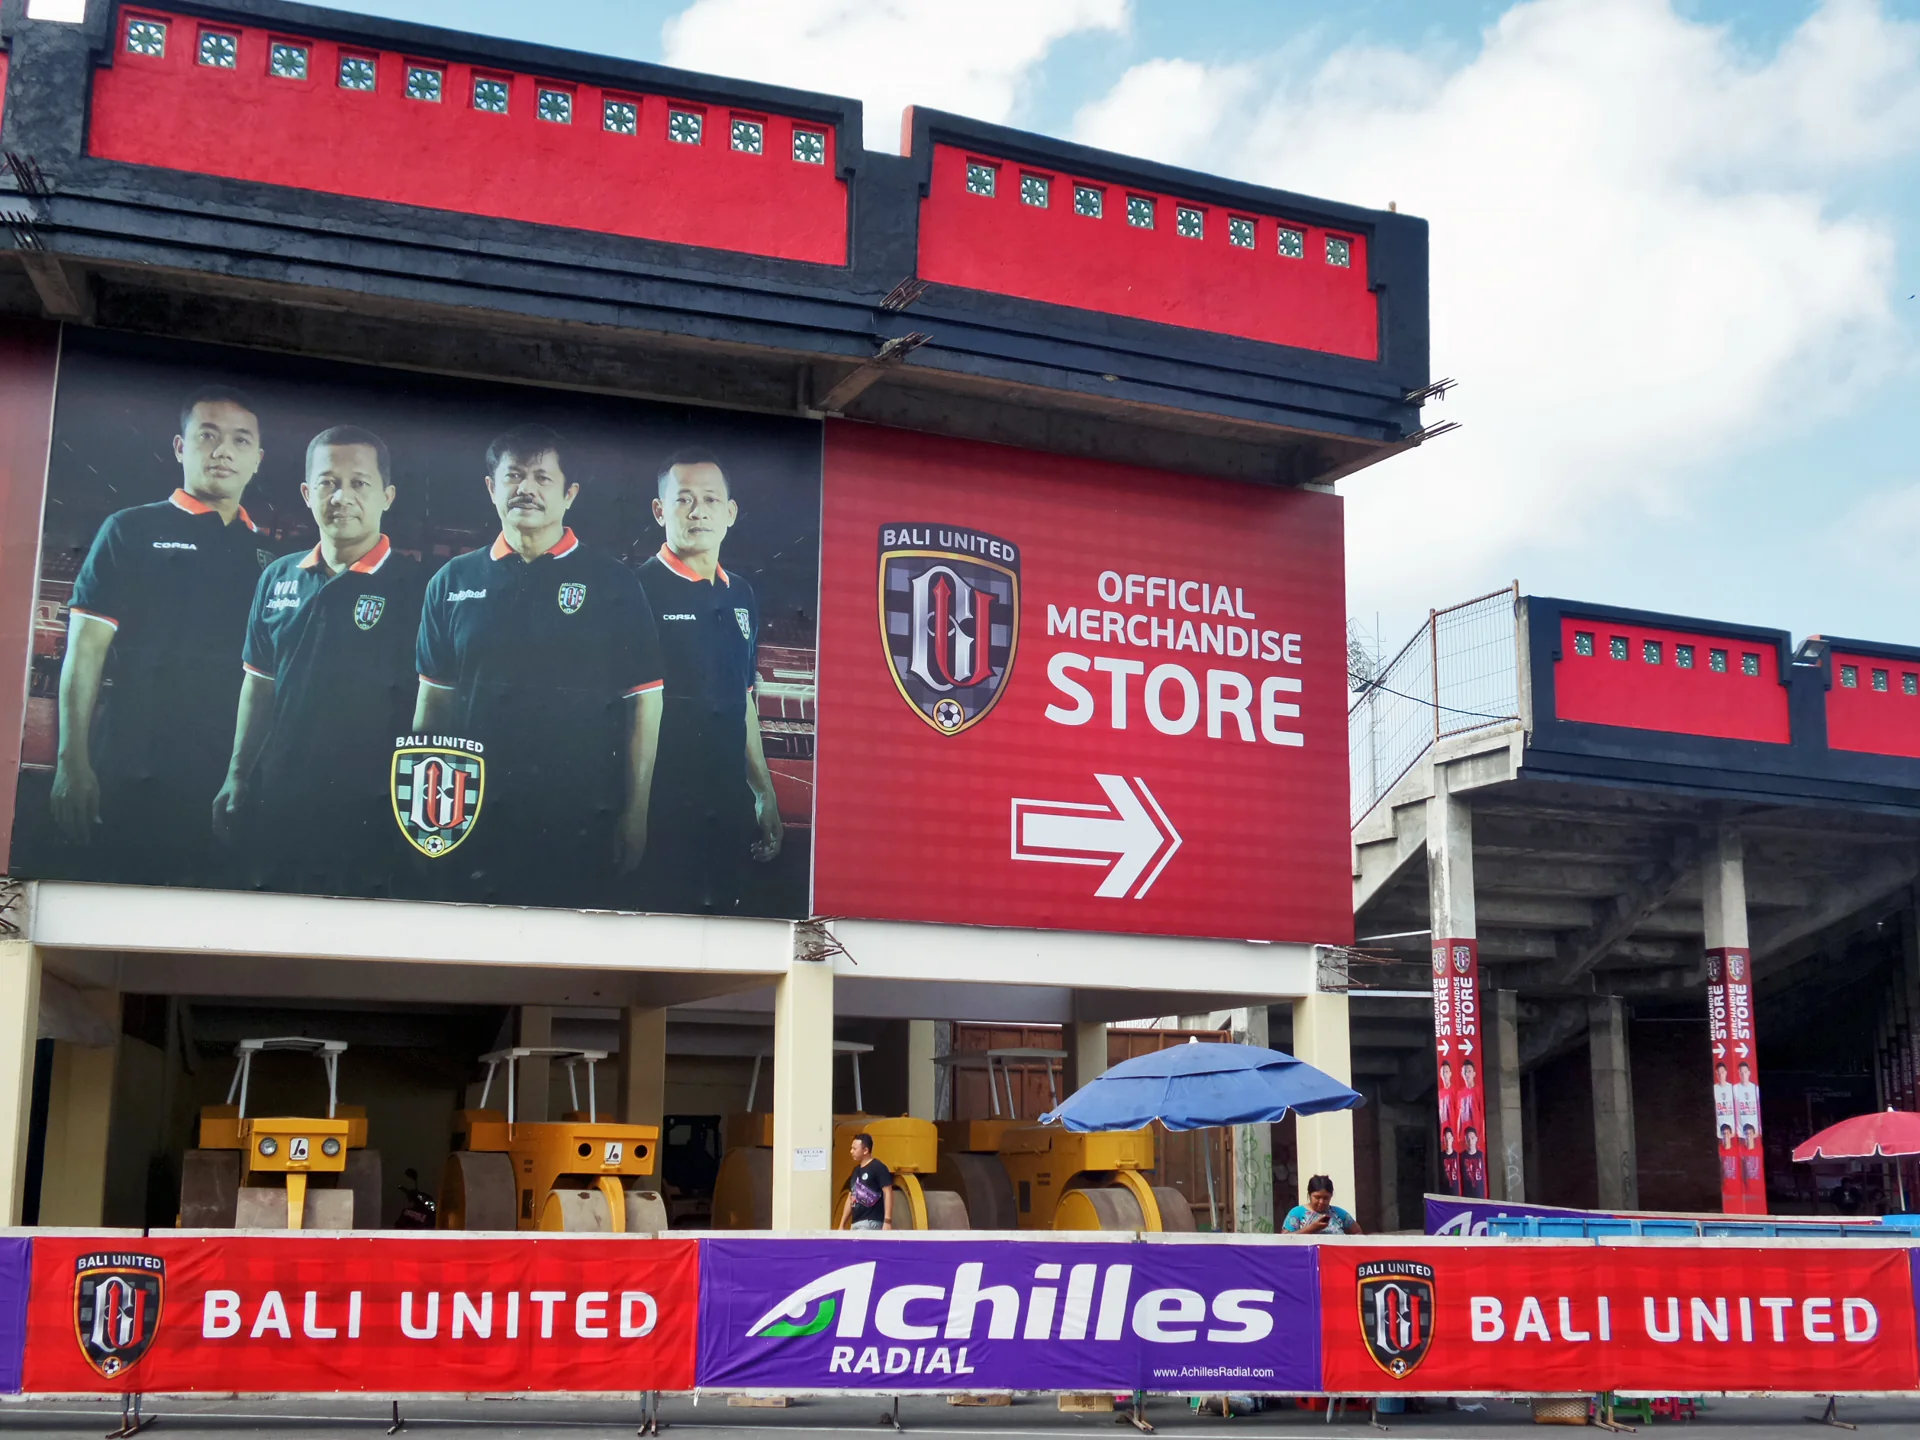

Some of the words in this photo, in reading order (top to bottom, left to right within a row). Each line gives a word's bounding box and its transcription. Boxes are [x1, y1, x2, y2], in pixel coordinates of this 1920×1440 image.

[152, 541, 198, 551] CORSA
[883, 529, 930, 546] BALI
[939, 530, 1015, 562] UNITED
[1097, 570, 1256, 620] OFFICIAL
[1046, 604, 1302, 665] MERCHANDISE
[1044, 652, 1304, 747] STORE
[395, 735, 428, 748] BALI
[432, 735, 484, 753] UNITED
[1433, 978, 1441, 1038] MERCHANDISE
[1438, 977, 1451, 1036] STORE
[1453, 976, 1462, 1036] MERCHANDISE
[1460, 977, 1475, 1036] STORE
[1707, 985, 1717, 1041] MERCHANDISE
[1713, 984, 1727, 1039] STORE
[1728, 983, 1739, 1040] MERCHANDISE
[1735, 984, 1750, 1039] STORE
[78, 1255, 107, 1269] BALI
[112, 1255, 161, 1269] UNITED
[1358, 1263, 1384, 1276] BALI
[1388, 1263, 1431, 1276] UNITED
[202, 1290, 361, 1339] BALI
[401, 1291, 658, 1338] UNITED
[745, 1261, 1275, 1343] Achilles
[1470, 1296, 1610, 1342] BALI
[1644, 1297, 1878, 1342] UNITED
[829, 1346, 975, 1374] RADIAL
[1153, 1366, 1274, 1378] www.AchillesRadial.com
